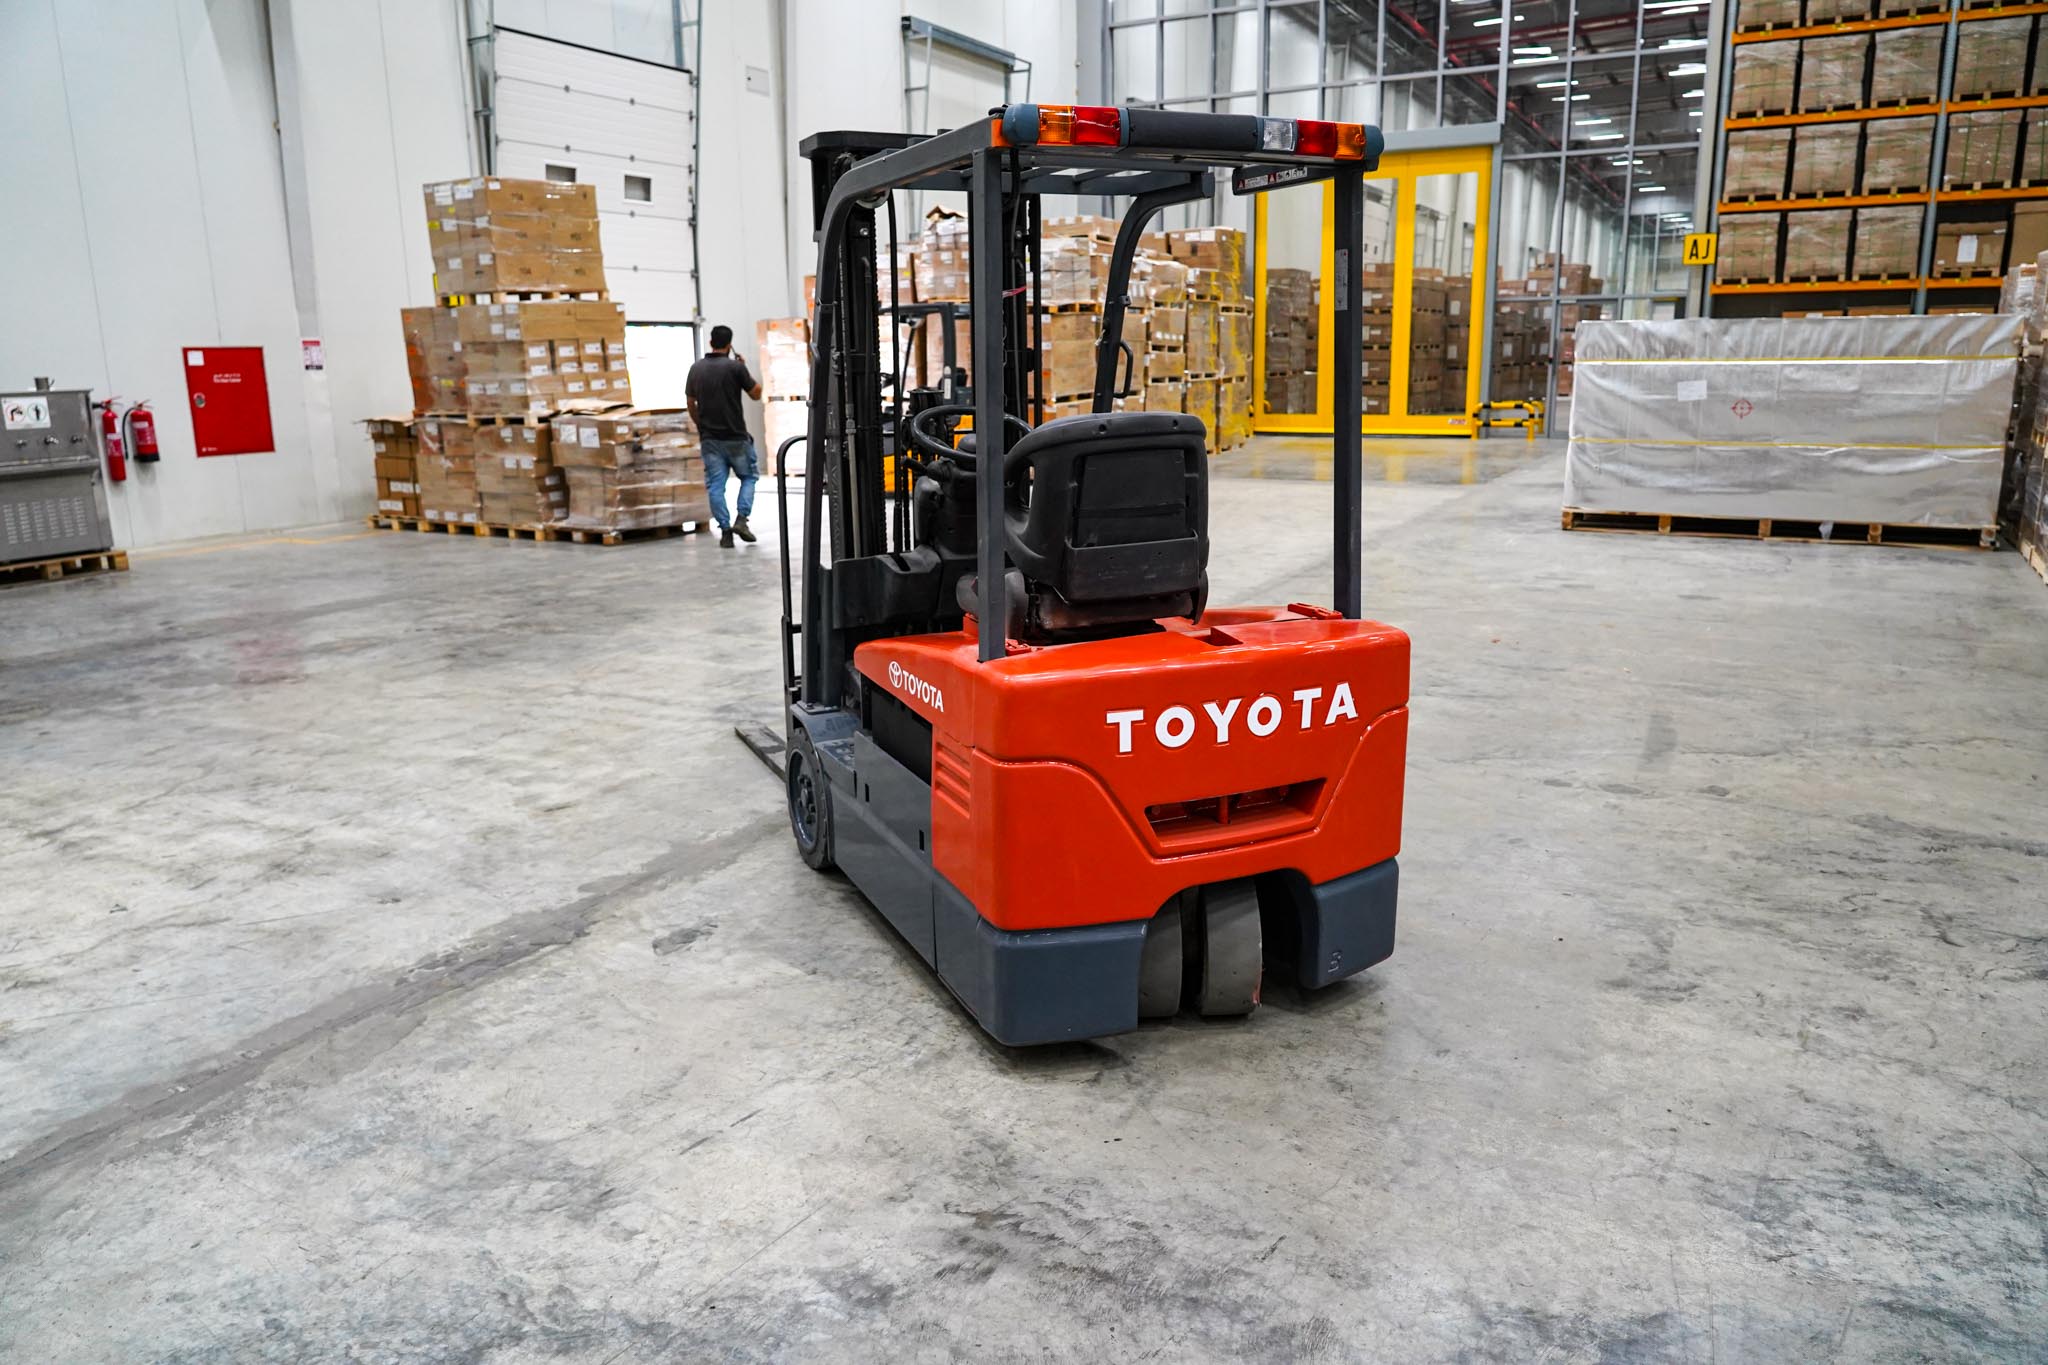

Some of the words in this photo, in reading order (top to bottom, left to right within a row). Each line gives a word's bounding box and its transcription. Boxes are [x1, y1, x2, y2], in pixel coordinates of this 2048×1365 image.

[1689, 238, 1710, 260] AJ
[903, 669, 944, 713] TOYOTA
[1106, 681, 1359, 753] TOYOTA
